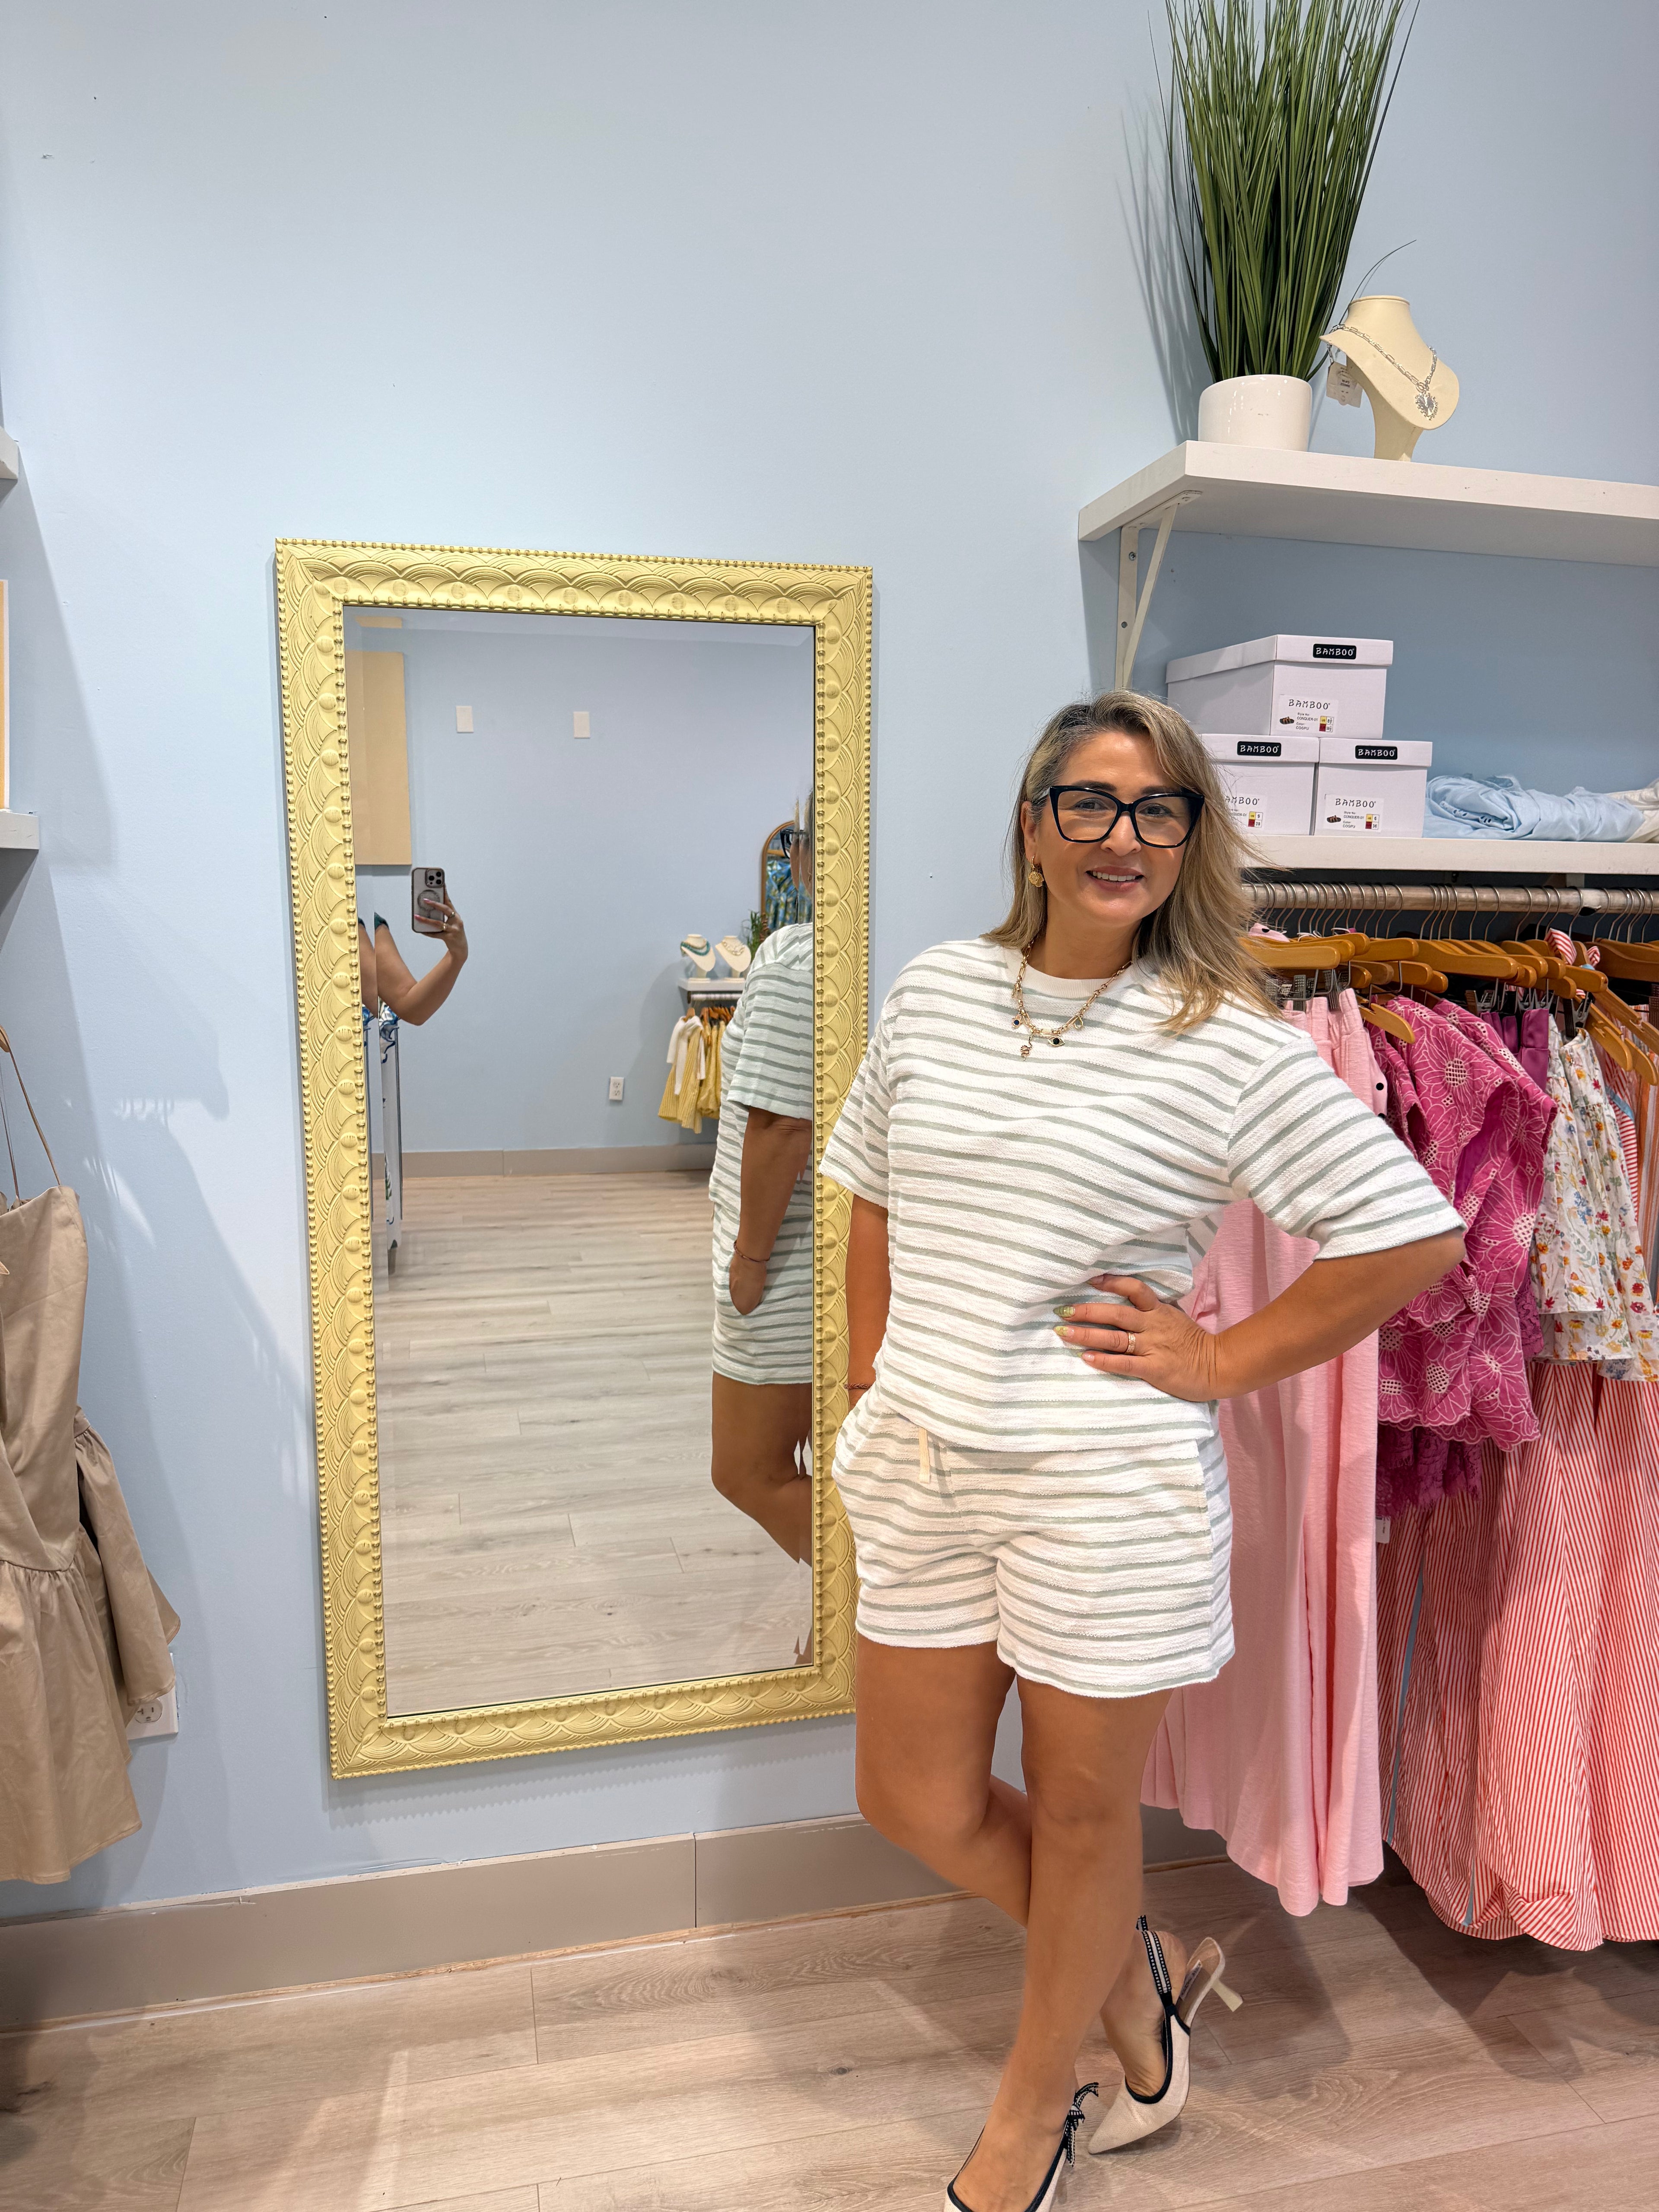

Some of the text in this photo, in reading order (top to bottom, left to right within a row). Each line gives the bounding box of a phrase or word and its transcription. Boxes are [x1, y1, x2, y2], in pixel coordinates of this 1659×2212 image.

[1316, 647, 1354, 656] BAMBOO
[1288, 699, 1329, 710] BAMBOO
[1240, 745, 1278, 753] BAMBOO
[1358, 749, 1395, 757] BAMBOO
[1225, 796, 1258, 805] AMBOO
[1335, 798, 1375, 808] BAMBOO
